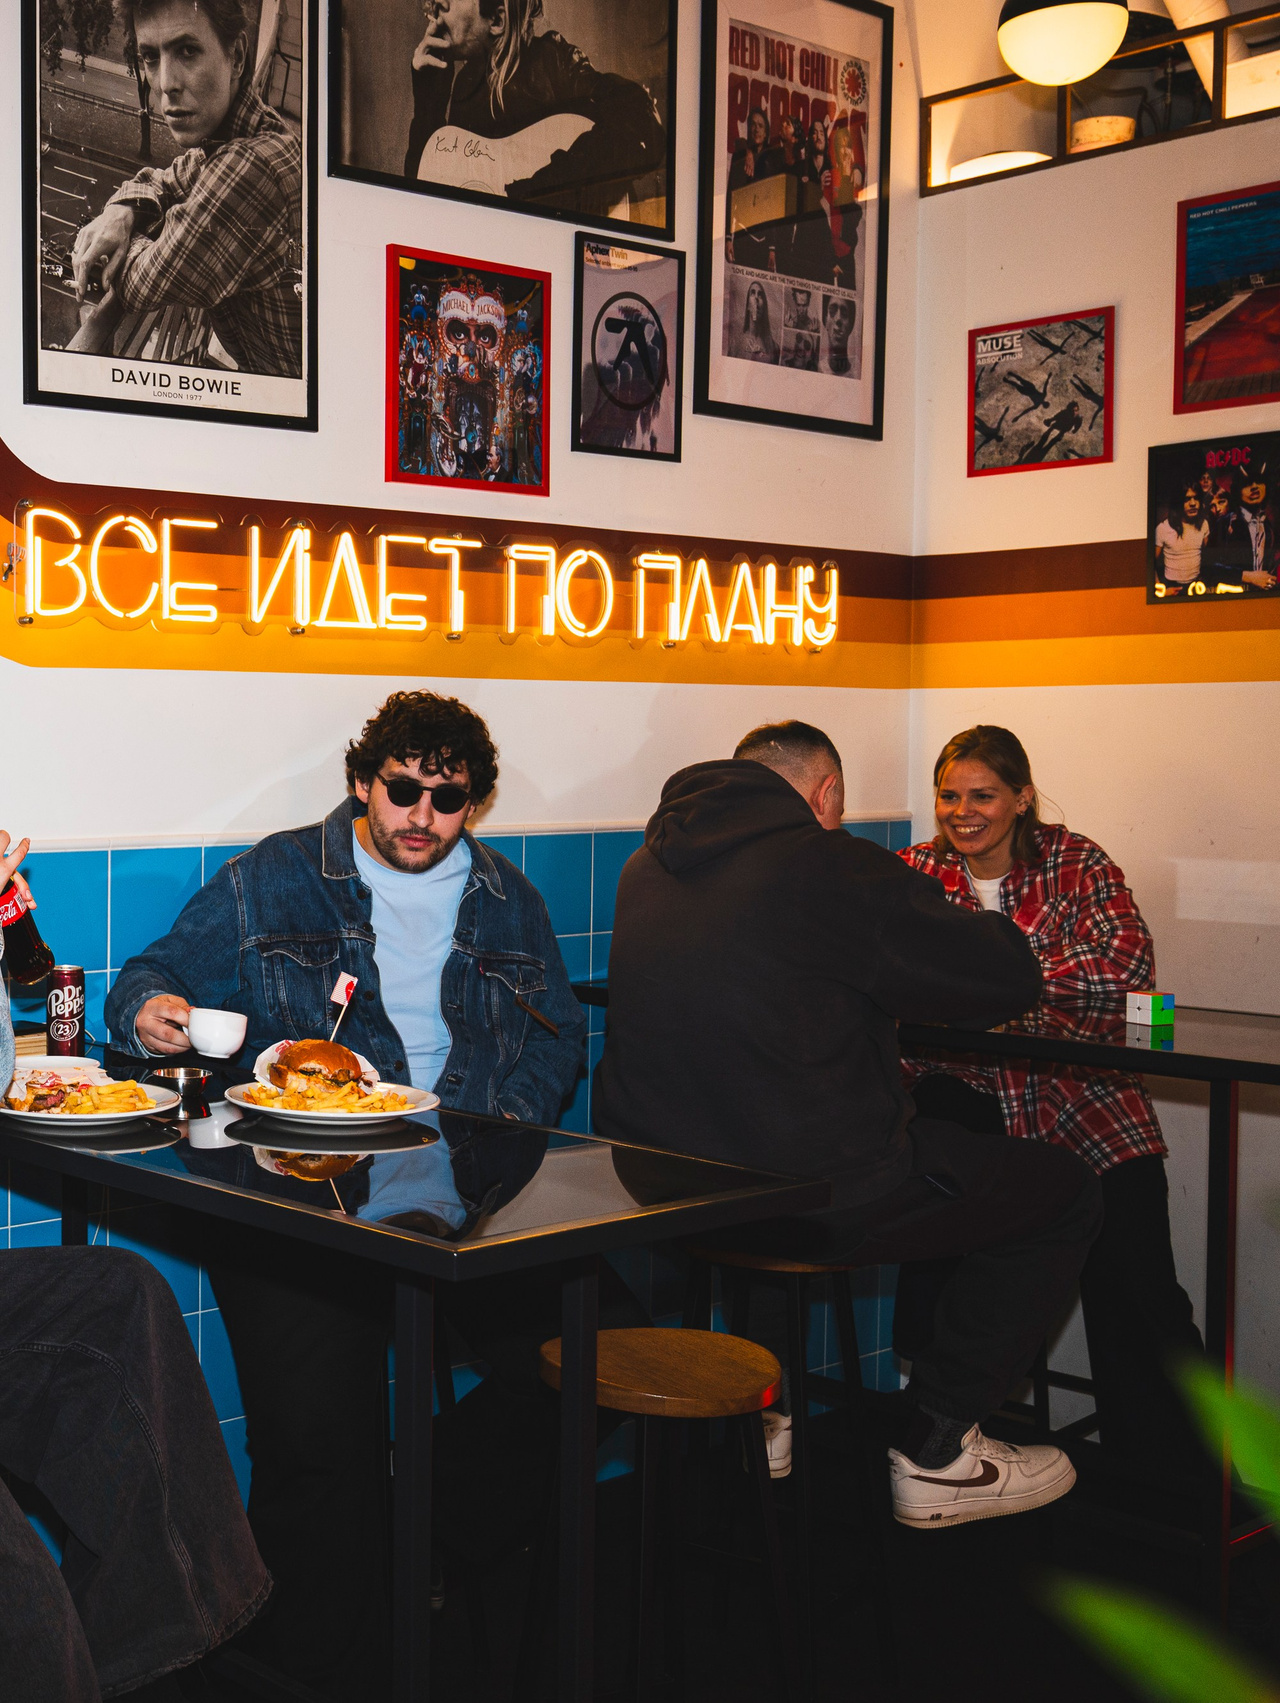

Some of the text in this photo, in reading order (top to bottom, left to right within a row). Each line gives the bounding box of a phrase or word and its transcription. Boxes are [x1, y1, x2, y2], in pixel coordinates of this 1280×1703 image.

[729, 25, 838, 96] RED HOT CHILI
[1231, 201, 1257, 210] PEPPERS
[585, 243, 628, 261] Aphex Twin
[442, 298, 469, 315] MICHAEL
[977, 335, 1021, 353] MUSE
[111, 368, 242, 396] DAVID BOWIE
[153, 390, 202, 402] LONDON 1977
[25, 508, 839, 647] ВСЕ ИДЕТ ПО ПЛАНУ
[63, 985, 82, 1002] Dr
[47, 989, 85, 1018] Peppe
[57, 1024, 70, 1036] 23
[929, 1512, 943, 1521] AIR
